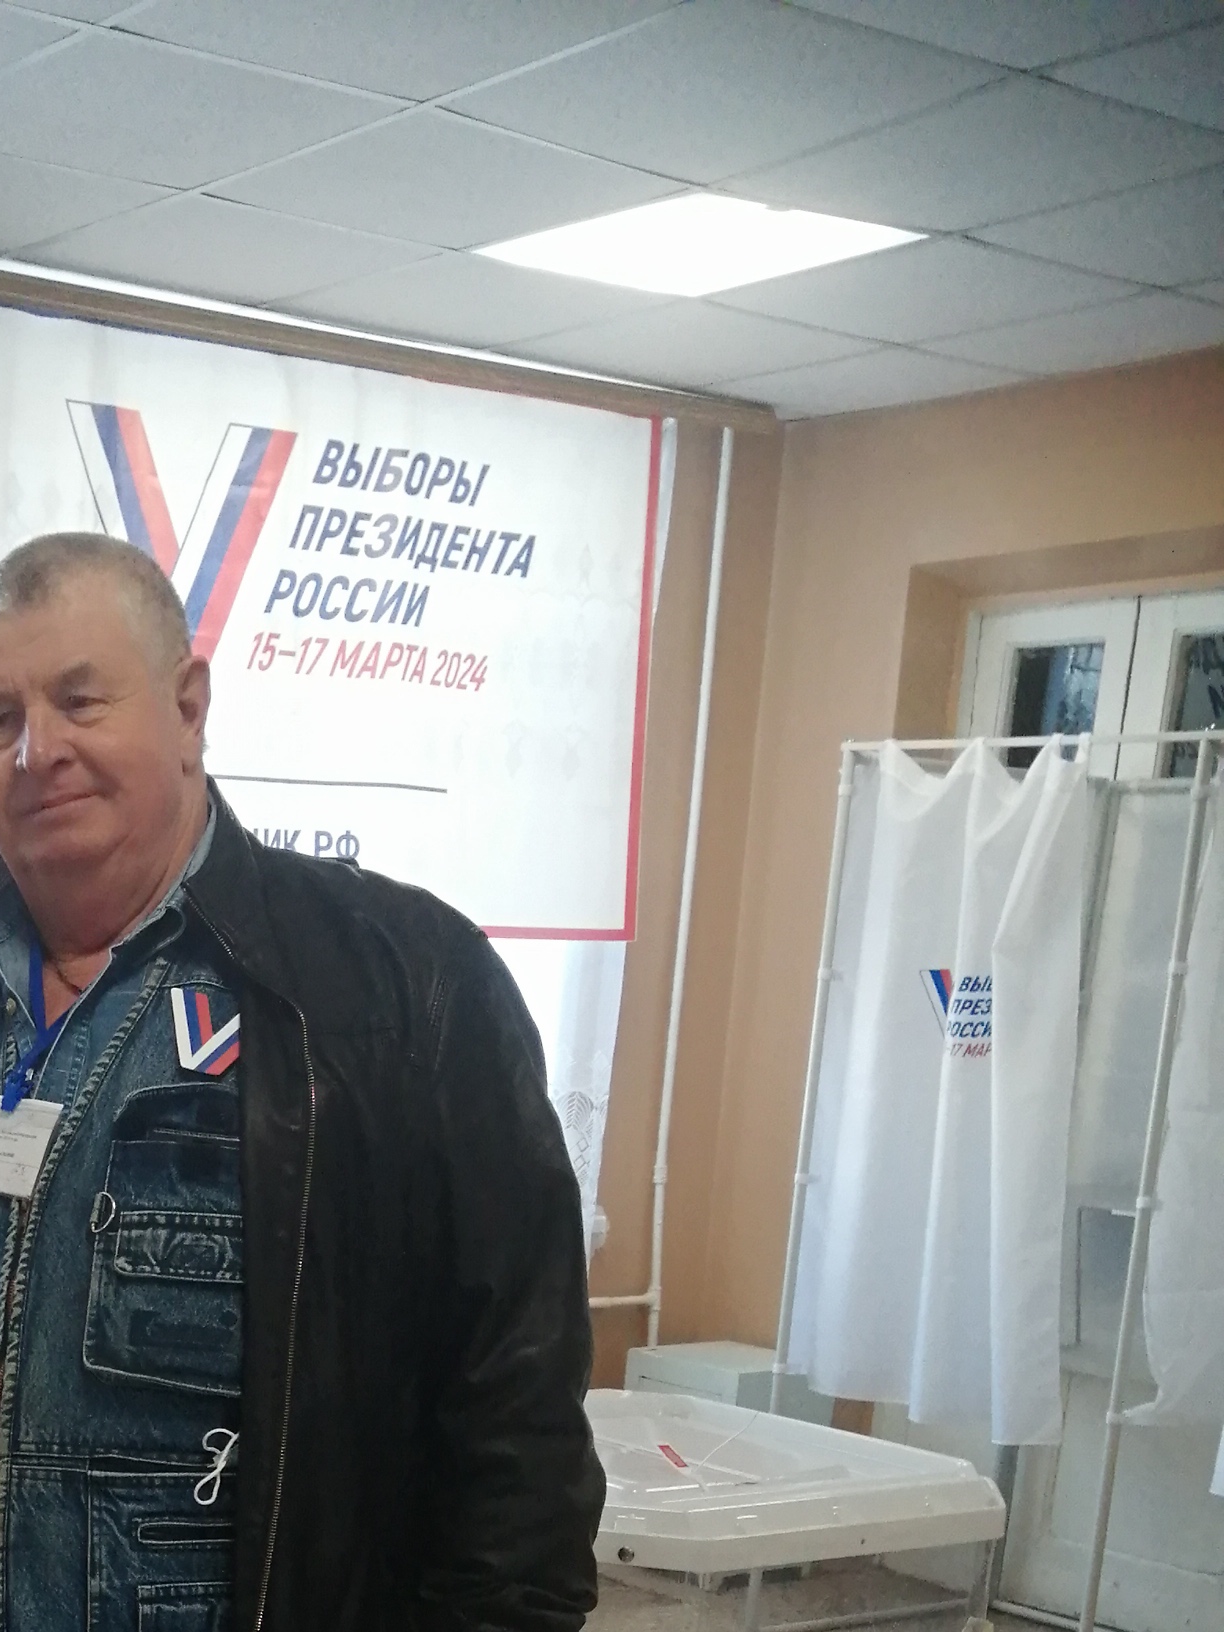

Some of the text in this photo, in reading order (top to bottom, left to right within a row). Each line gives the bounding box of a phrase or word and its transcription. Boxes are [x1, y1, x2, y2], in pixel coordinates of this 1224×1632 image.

[312, 438, 491, 507] ВЫБОРЫ
[288, 504, 537, 579] ПРЕЗИДЕНТА
[263, 568, 431, 628] РОССИИ
[329, 639, 429, 684] МАРТА
[429, 648, 489, 692] 2024
[314, 830, 361, 858] РФ
